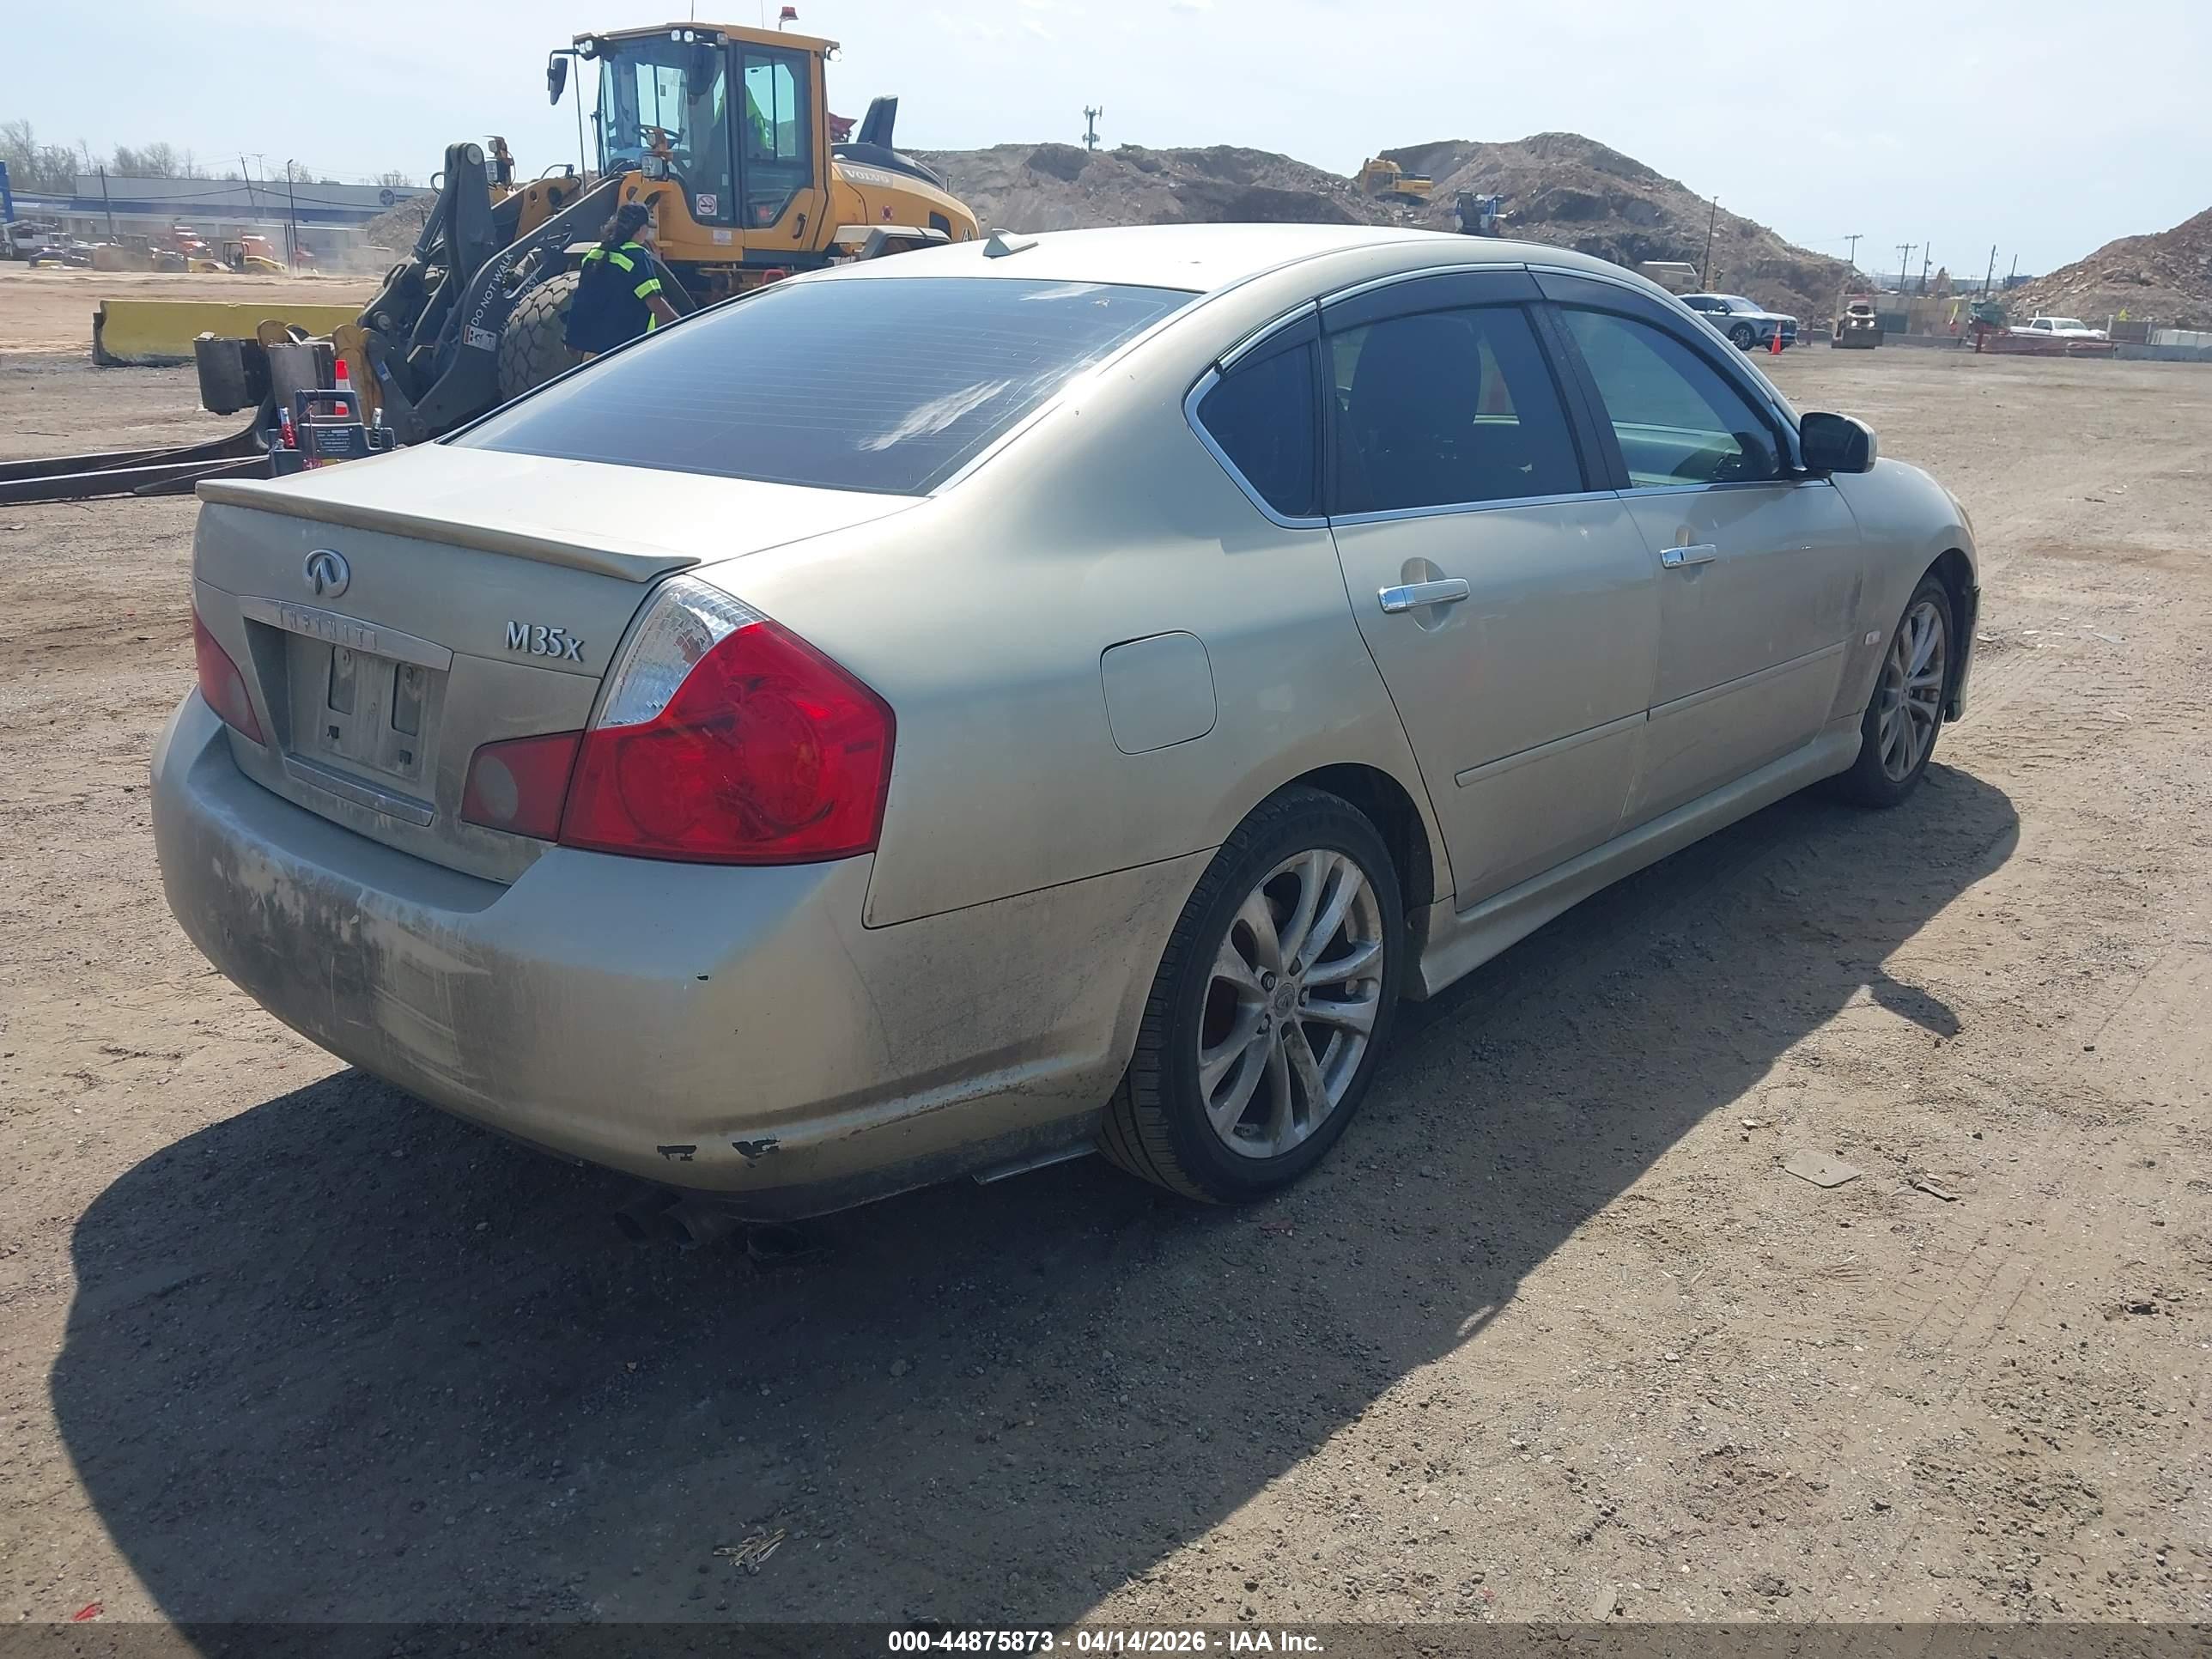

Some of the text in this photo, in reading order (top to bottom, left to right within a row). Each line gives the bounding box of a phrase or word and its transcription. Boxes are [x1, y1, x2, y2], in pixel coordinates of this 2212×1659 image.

[844, 169, 890, 184] VOLVO
[471, 309, 484, 326] DO
[481, 283, 496, 308] NOT
[493, 252, 514, 283] WALK
[276, 600, 377, 651] INFINITI
